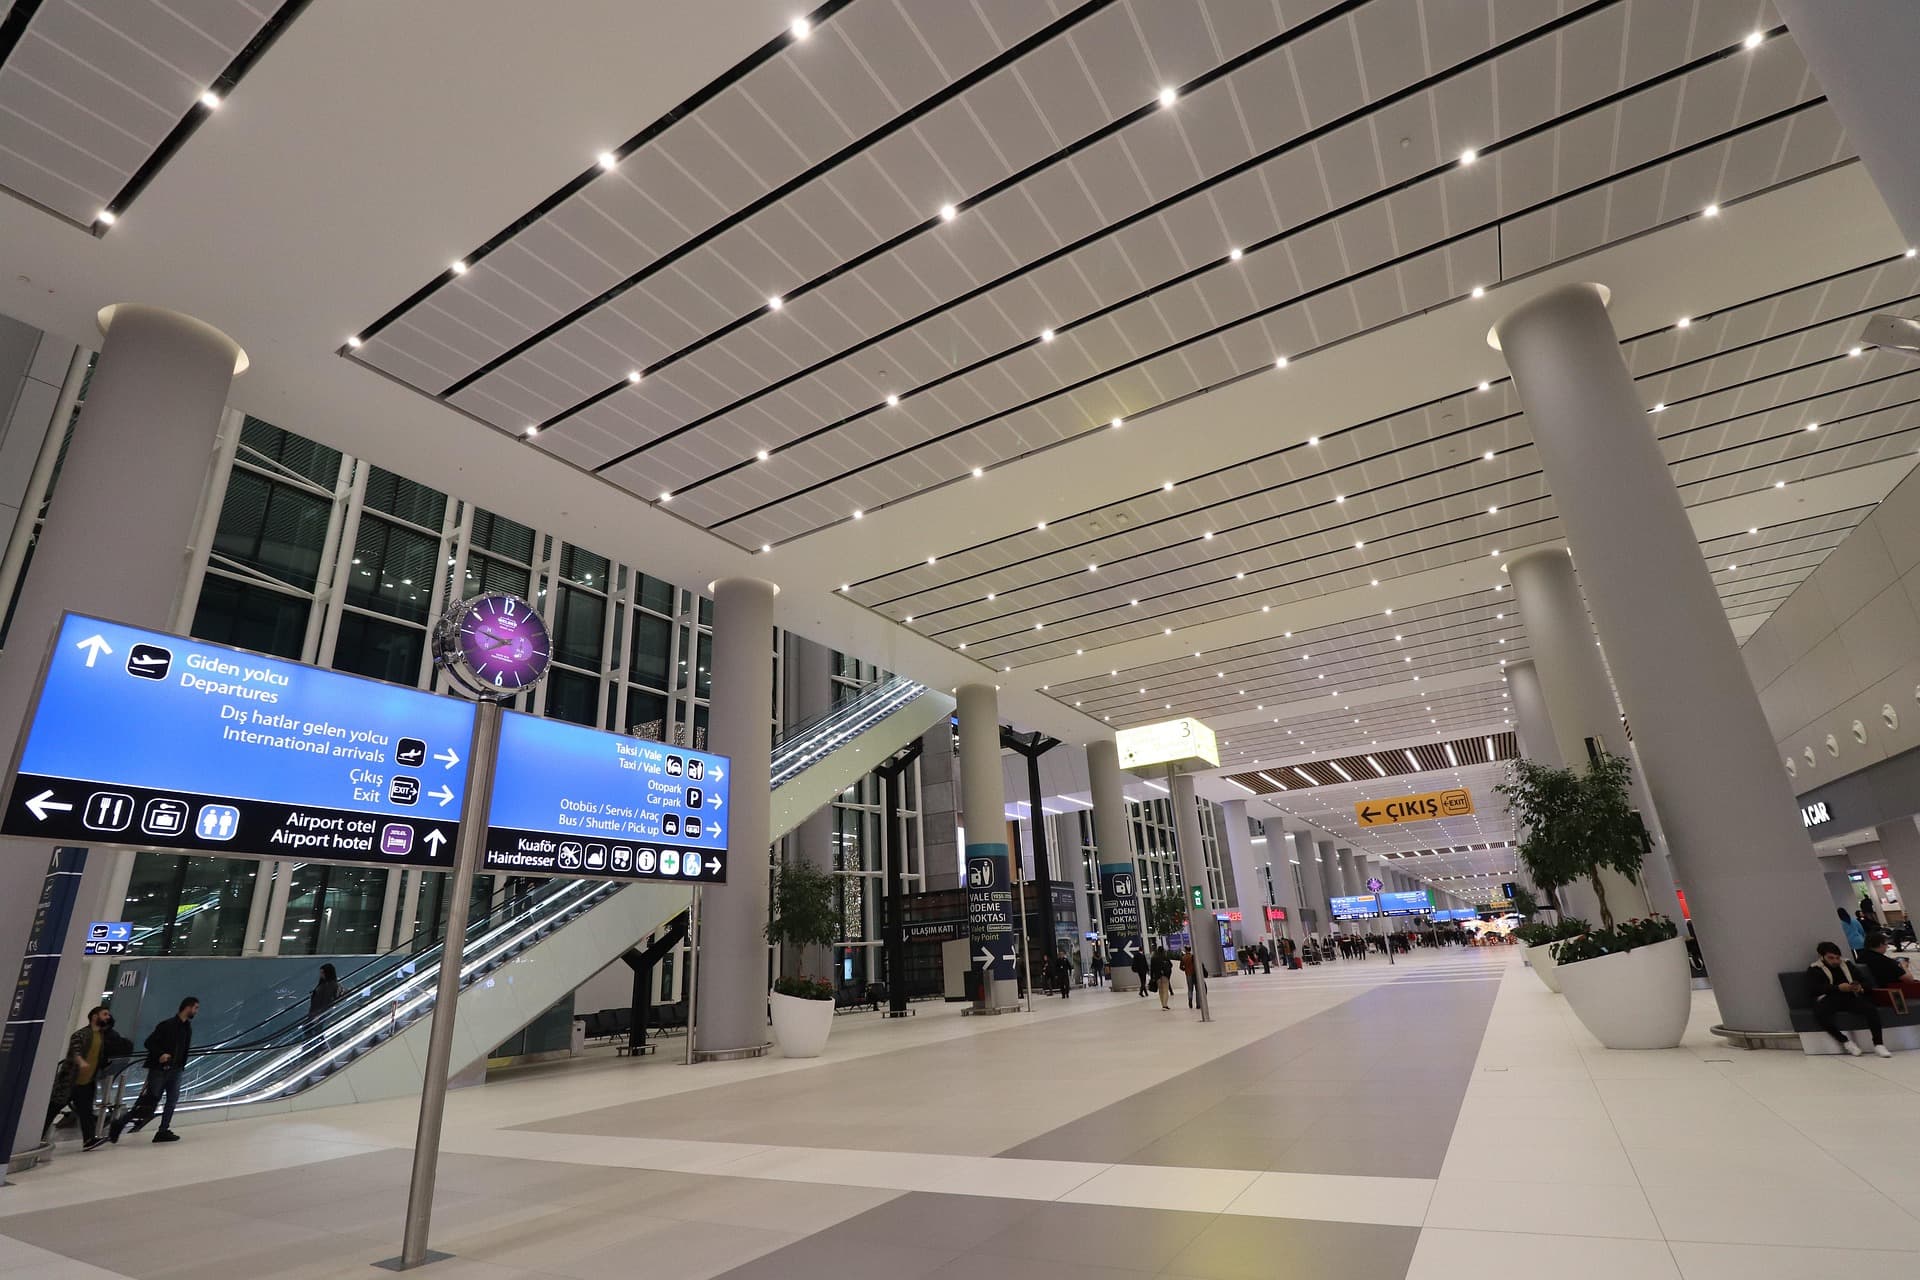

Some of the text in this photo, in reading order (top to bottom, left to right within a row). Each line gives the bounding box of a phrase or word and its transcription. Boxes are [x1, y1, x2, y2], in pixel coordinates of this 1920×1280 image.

[504, 597, 515, 617] 12
[186, 654, 289, 687] Giden yolcu
[495, 671, 503, 687] 6
[180, 672, 279, 704] Departures
[220, 704, 389, 746] Dış hatlar gelen yolcu
[1180, 721, 1191, 737] 3
[223, 725, 386, 763] International arrivals
[615, 742, 638, 757] Taksi
[643, 748, 662, 762] Vale
[619, 757, 637, 770] Taxi
[642, 761, 662, 775] Vale
[349, 768, 384, 787] Çıkış
[648, 779, 682, 794] Otopark
[353, 787, 381, 803] Exit
[394, 785, 410, 795] EXIT
[646, 793, 682, 808] Car park
[1449, 799, 1466, 807] EXIT
[560, 798, 597, 814] Otobüs
[605, 804, 633, 818] Servis
[640, 809, 660, 823] Araç
[1385, 798, 1438, 822] ÇIKIŞ
[1808, 801, 1831, 825] CAR
[286, 812, 376, 834] Airport otel
[559, 813, 577, 826] Bus
[586, 816, 620, 831] Shuttle
[628, 821, 646, 834] Pick
[647, 825, 660, 837] up
[270, 829, 373, 851] Airport hotel
[518, 838, 557, 853] Kuaför
[487, 850, 555, 867] Hairdresser
[970, 892, 990, 901] VALE
[1120, 899, 1135, 907] VALE
[970, 902, 1001, 912] ÖDEME
[970, 913, 1006, 923] NOKTASI
[911, 925, 954, 937] ULAŞIM KATI
[119, 970, 137, 988] ATM
